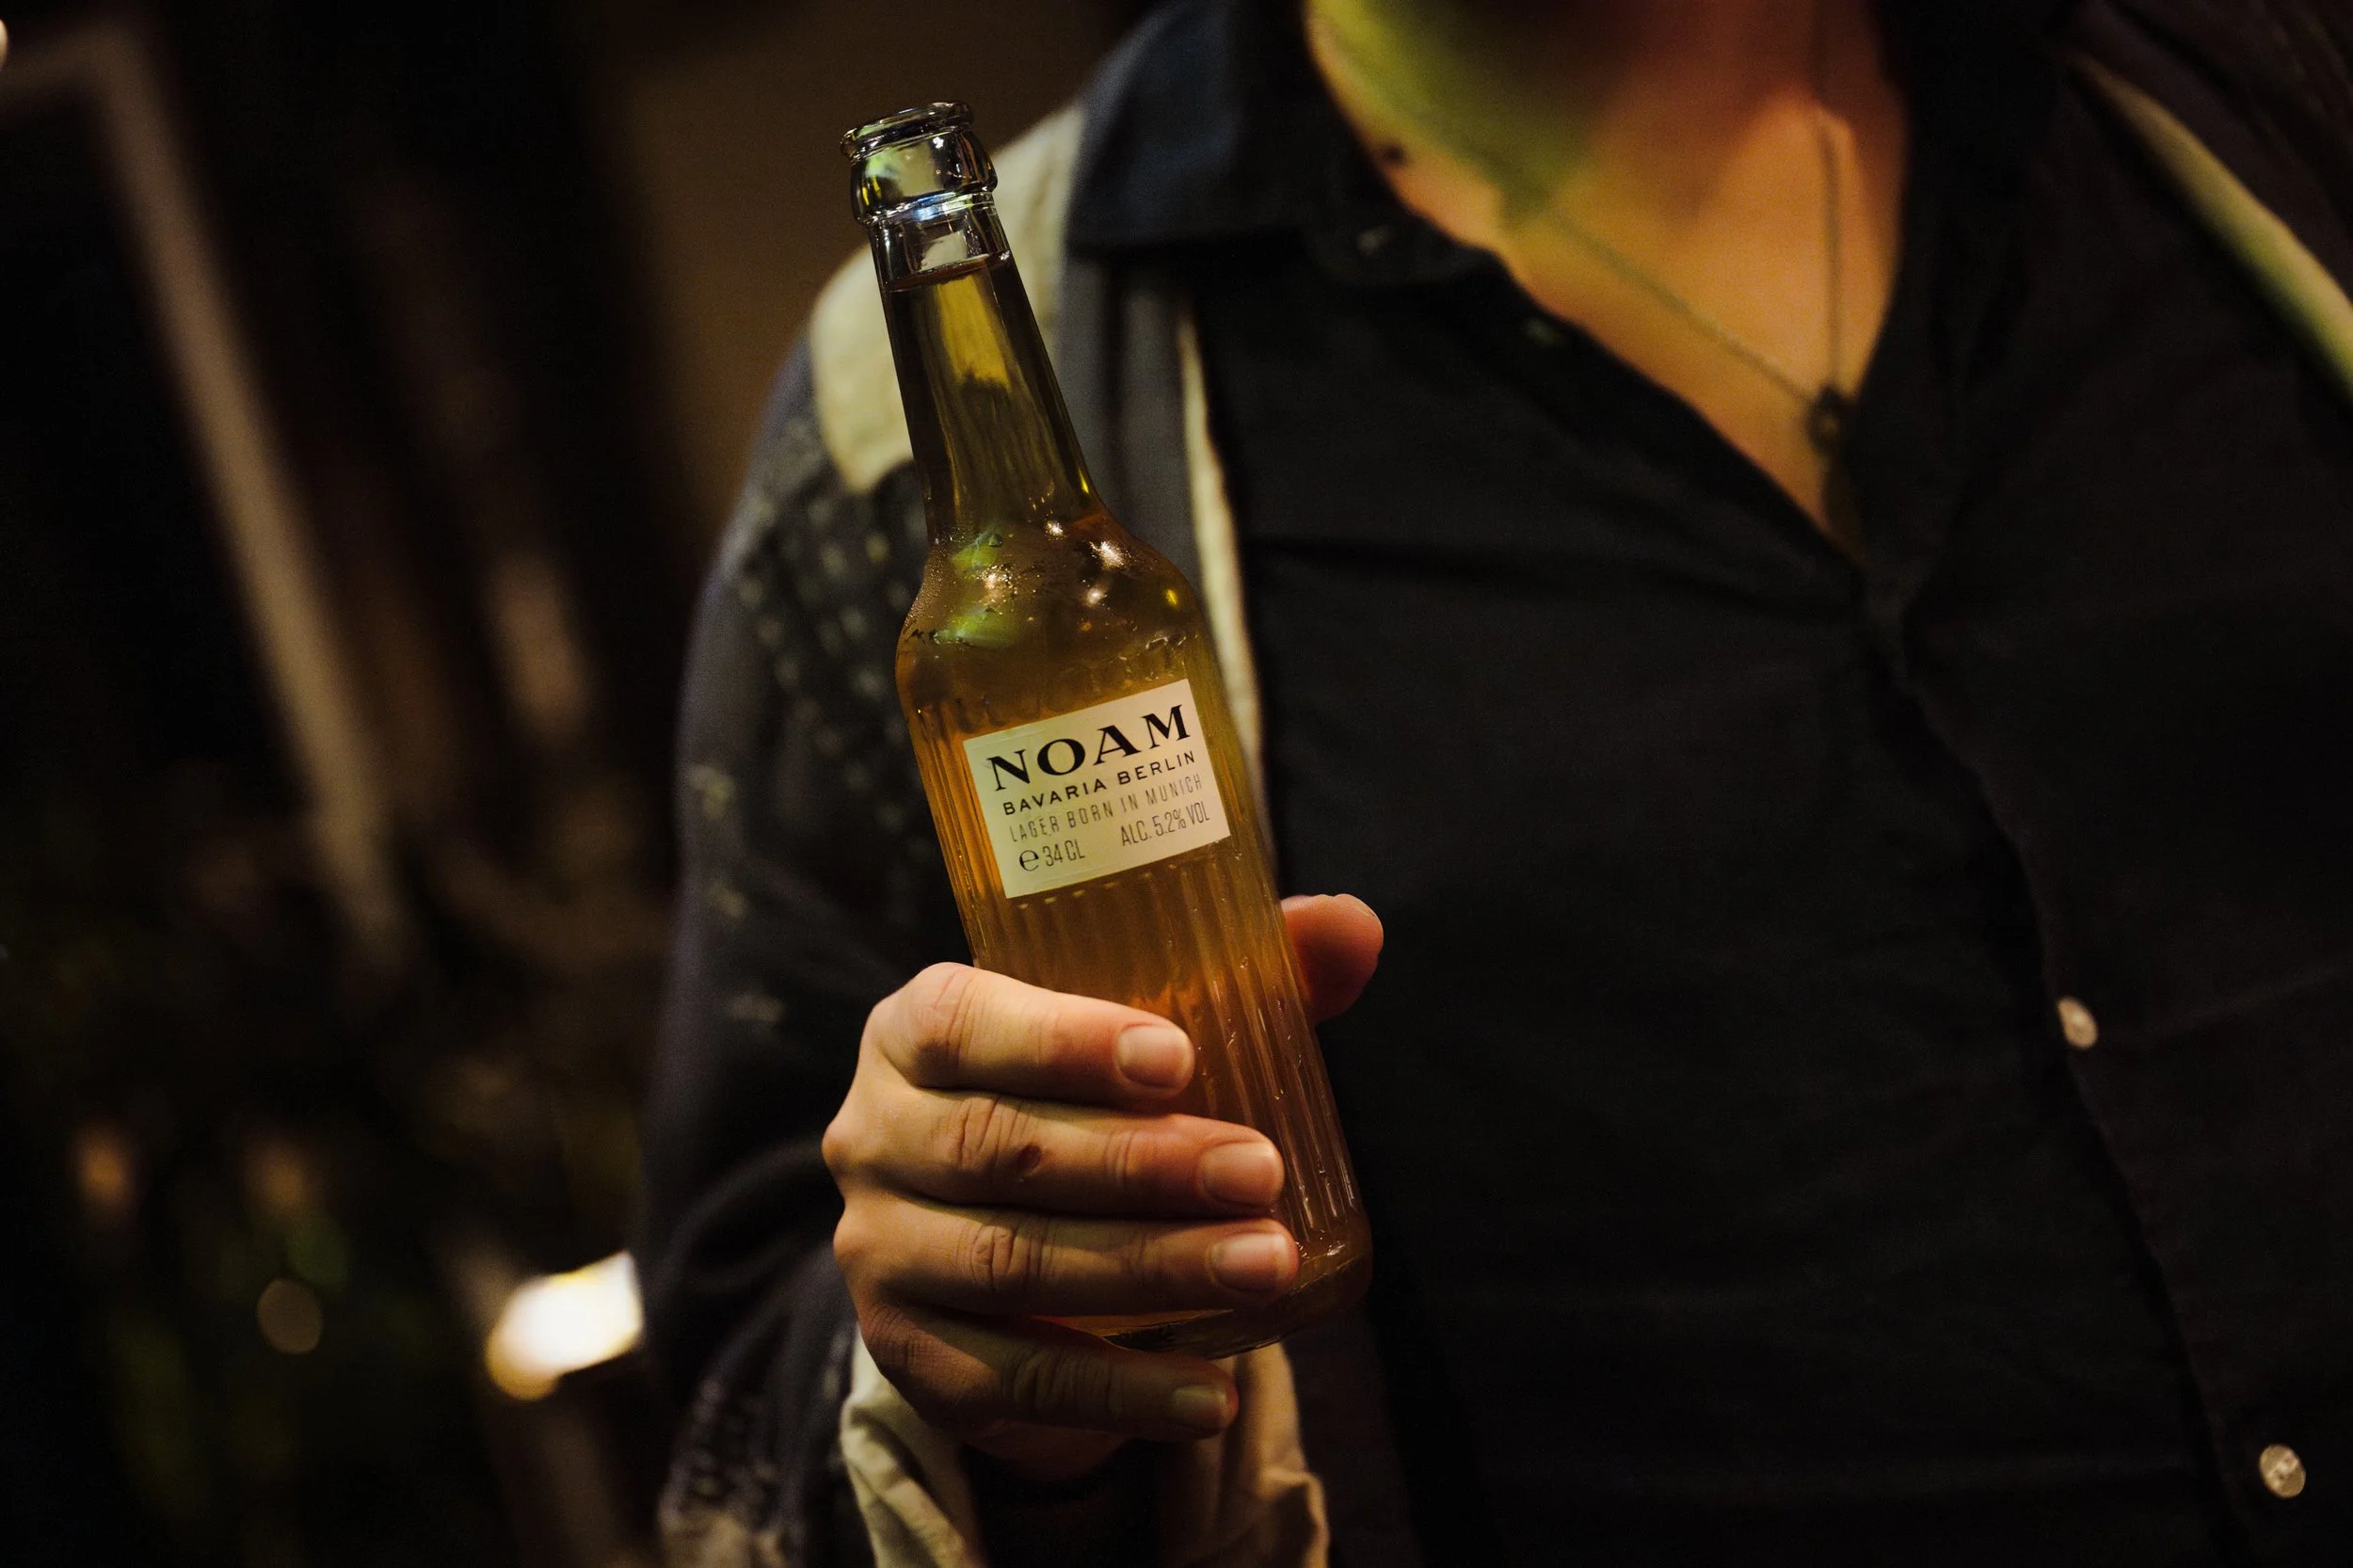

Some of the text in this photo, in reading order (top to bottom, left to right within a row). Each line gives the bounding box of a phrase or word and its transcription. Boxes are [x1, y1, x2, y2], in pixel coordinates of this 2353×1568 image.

[986, 704, 1191, 792] NOAM
[1002, 750, 1195, 816] BAVARIA BERLIN
[1009, 774, 1203, 842] LAGER BORN IN MUNICH
[1121, 801, 1210, 847] ALC. 5.2% VOL
